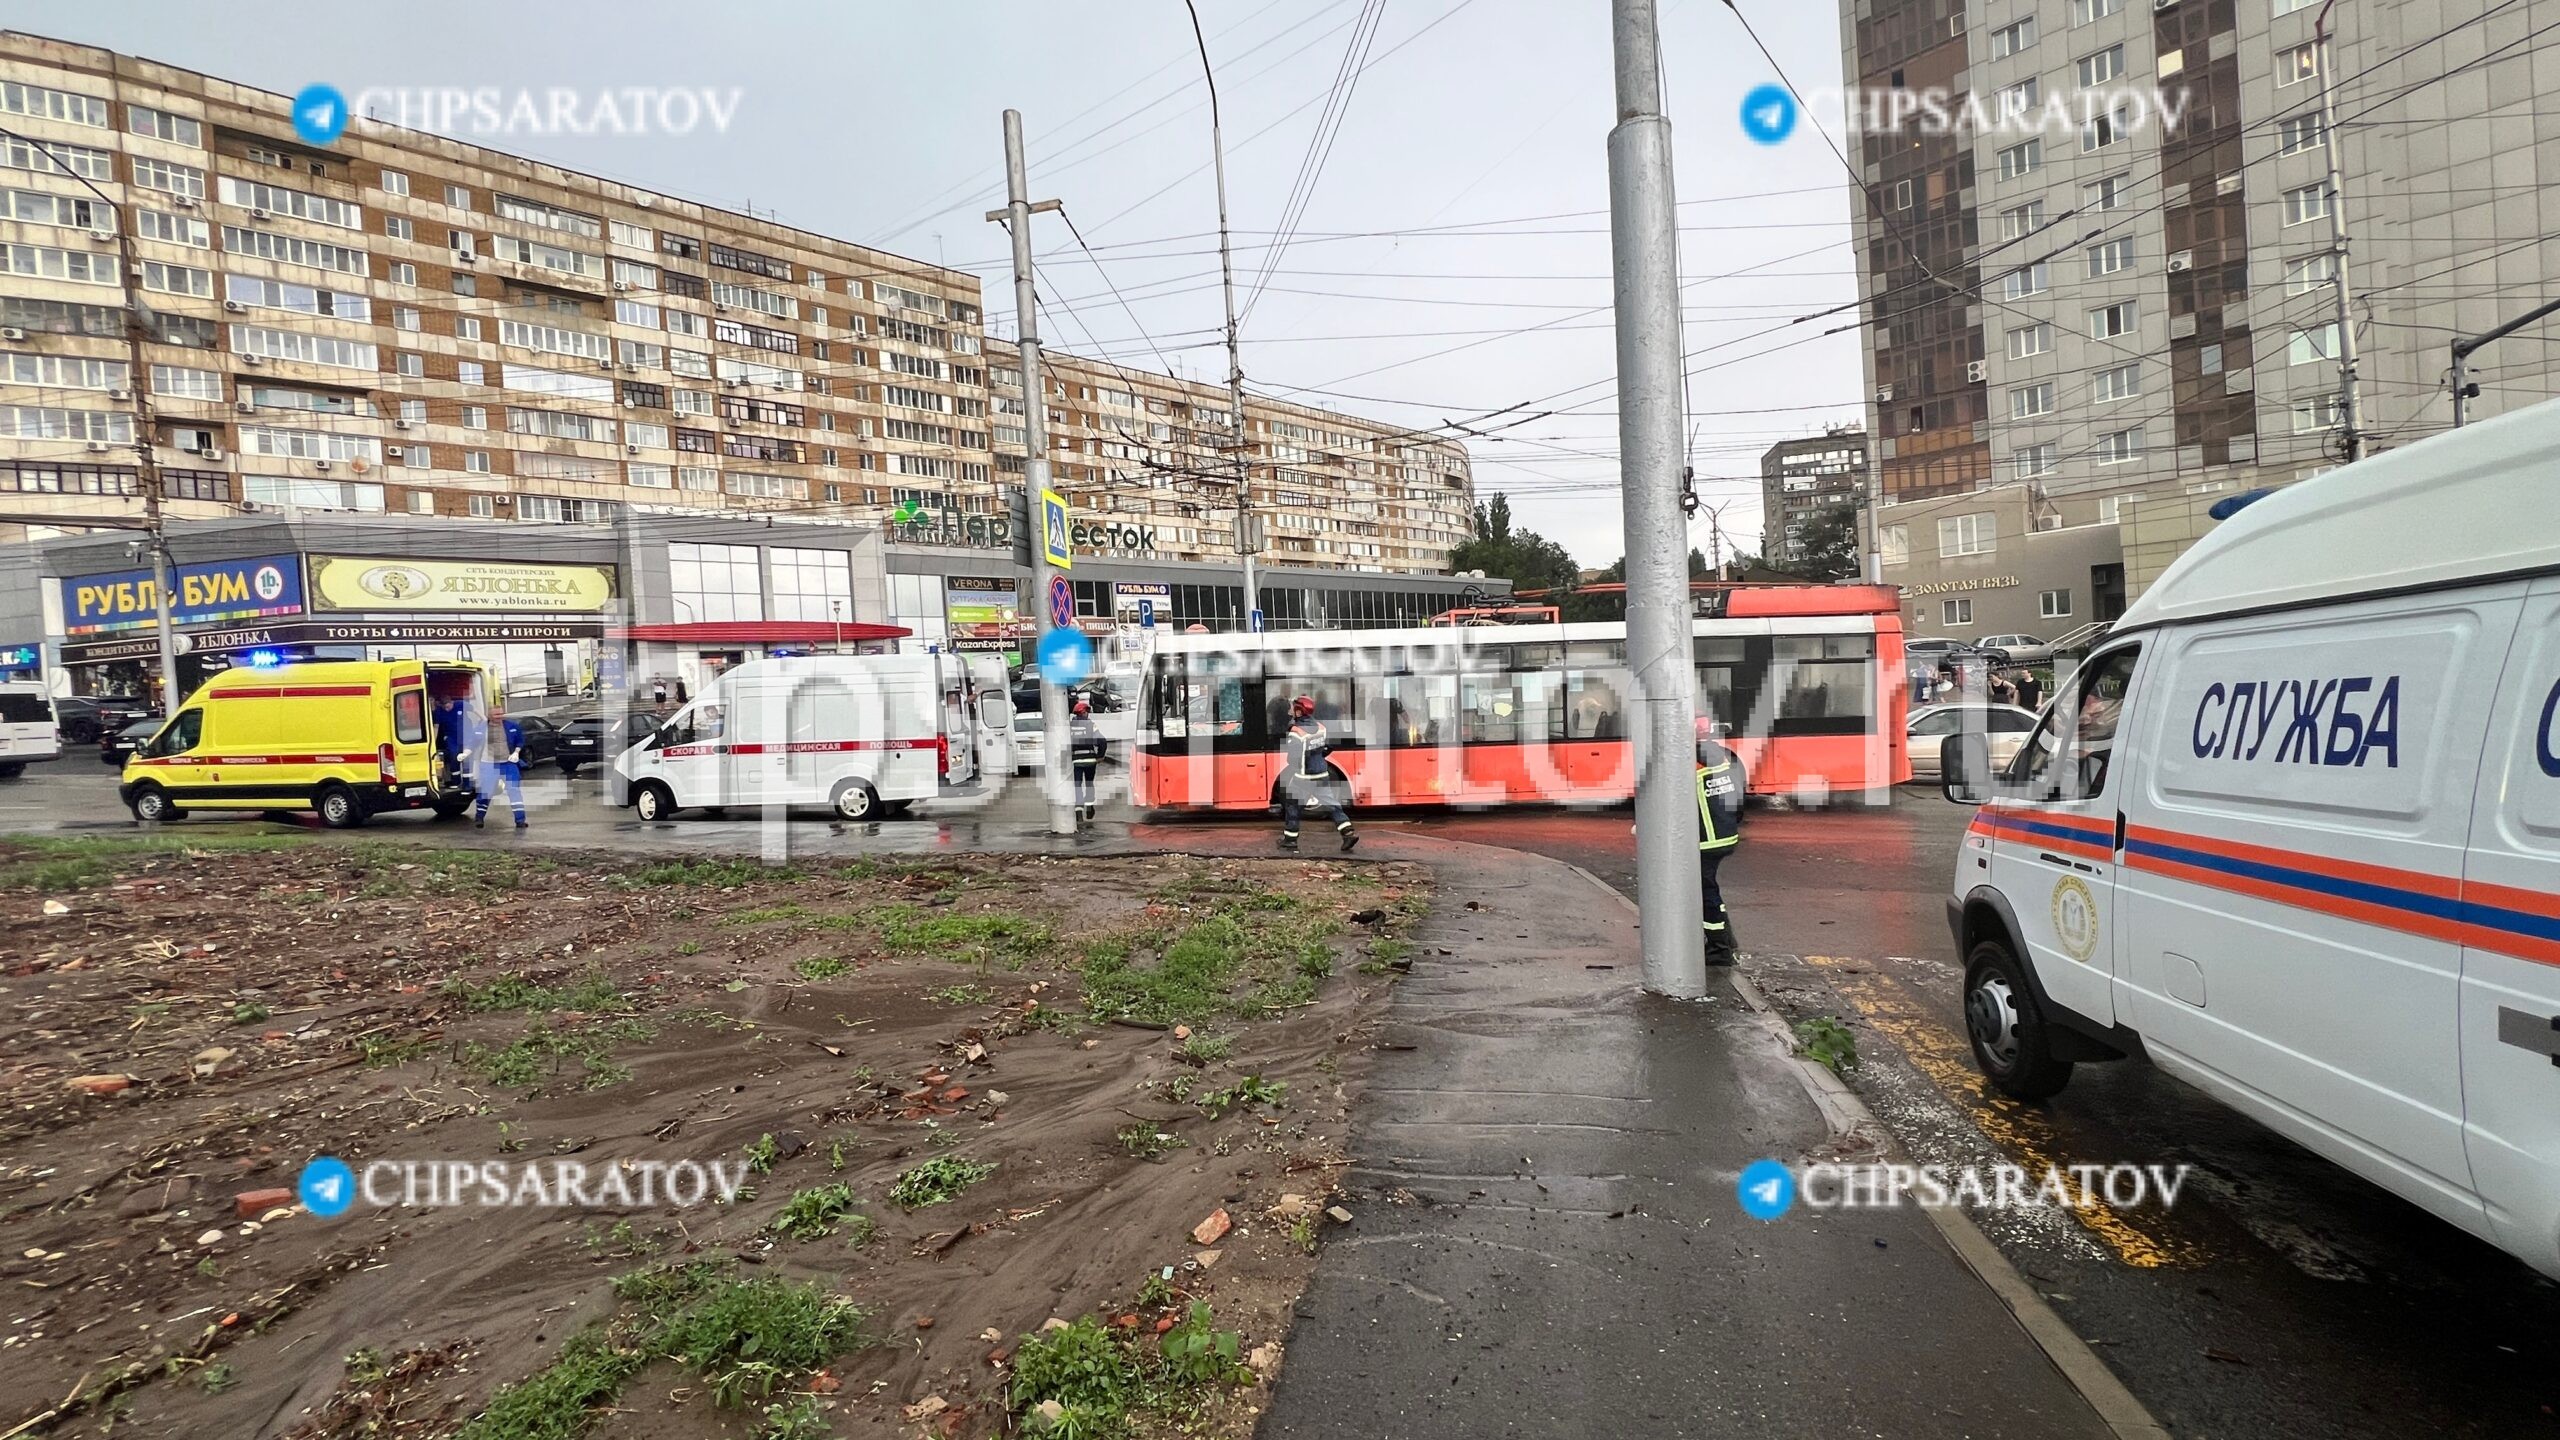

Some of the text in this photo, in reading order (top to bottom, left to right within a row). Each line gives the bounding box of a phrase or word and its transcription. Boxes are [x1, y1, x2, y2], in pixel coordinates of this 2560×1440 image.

[942, 504, 1154, 550] Перёсток
[182, 570, 250, 607] БУМ
[440, 576, 582, 595] ЯБЛОНЬКА
[953, 579, 993, 589] VERONA
[1118, 584, 1159, 594] РУБЛЬ БУМ
[1914, 575, 2020, 597] ЗОЛОТАЯ ВЯЗЬ
[459, 595, 568, 606] www.yablonka.ru
[326, 627, 571, 638] ТОРТЫ ПИРОЖНЫЕ ПИРОГИ
[1086, 622, 1116, 631] ПИЦЦА
[197, 629, 272, 648] ЯБЛОНЬКА
[2192, 675, 2400, 768] СЛУЖБА
[670, 740, 913, 755] СКОРАЯ МЕДИЦИНСКАЯ ПОМОЩЬ
